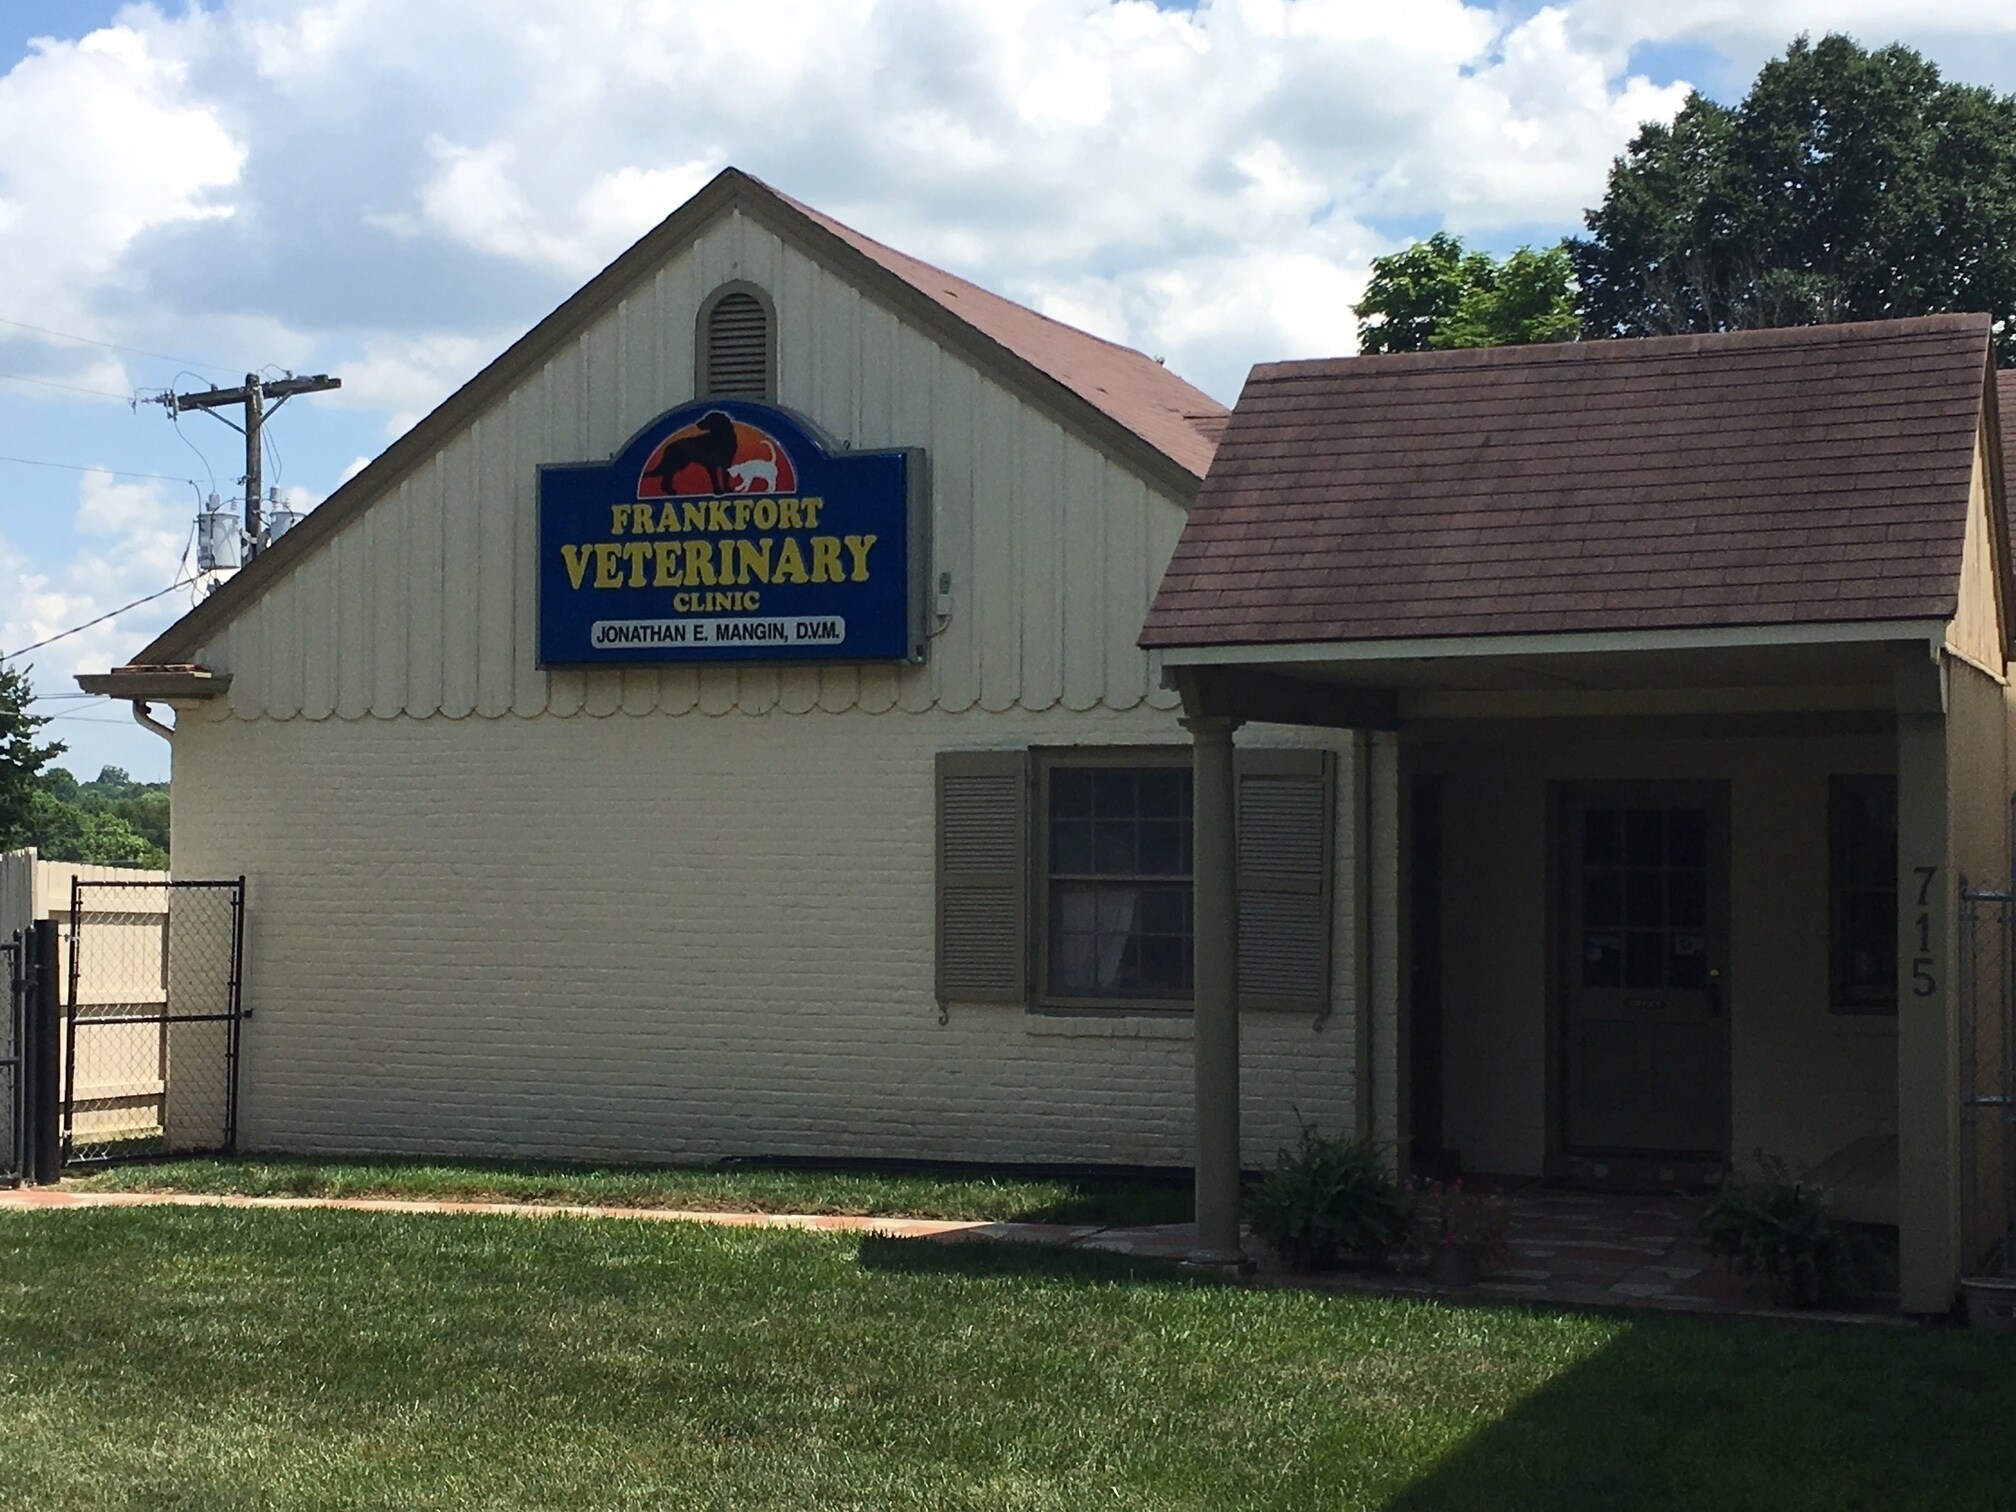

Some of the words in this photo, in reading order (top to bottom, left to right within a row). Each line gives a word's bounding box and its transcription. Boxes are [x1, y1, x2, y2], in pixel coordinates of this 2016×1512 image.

[611, 497, 824, 535] FRANKFORT
[561, 535, 878, 590] VETERINARY
[673, 591, 760, 612] CLINIC
[596, 624, 686, 643] JONATHAN
[693, 625, 708, 641] E.
[716, 623, 788, 642] MANGIN,
[796, 622, 840, 640] D.V.M.
[1913, 866, 1938, 997] 715
